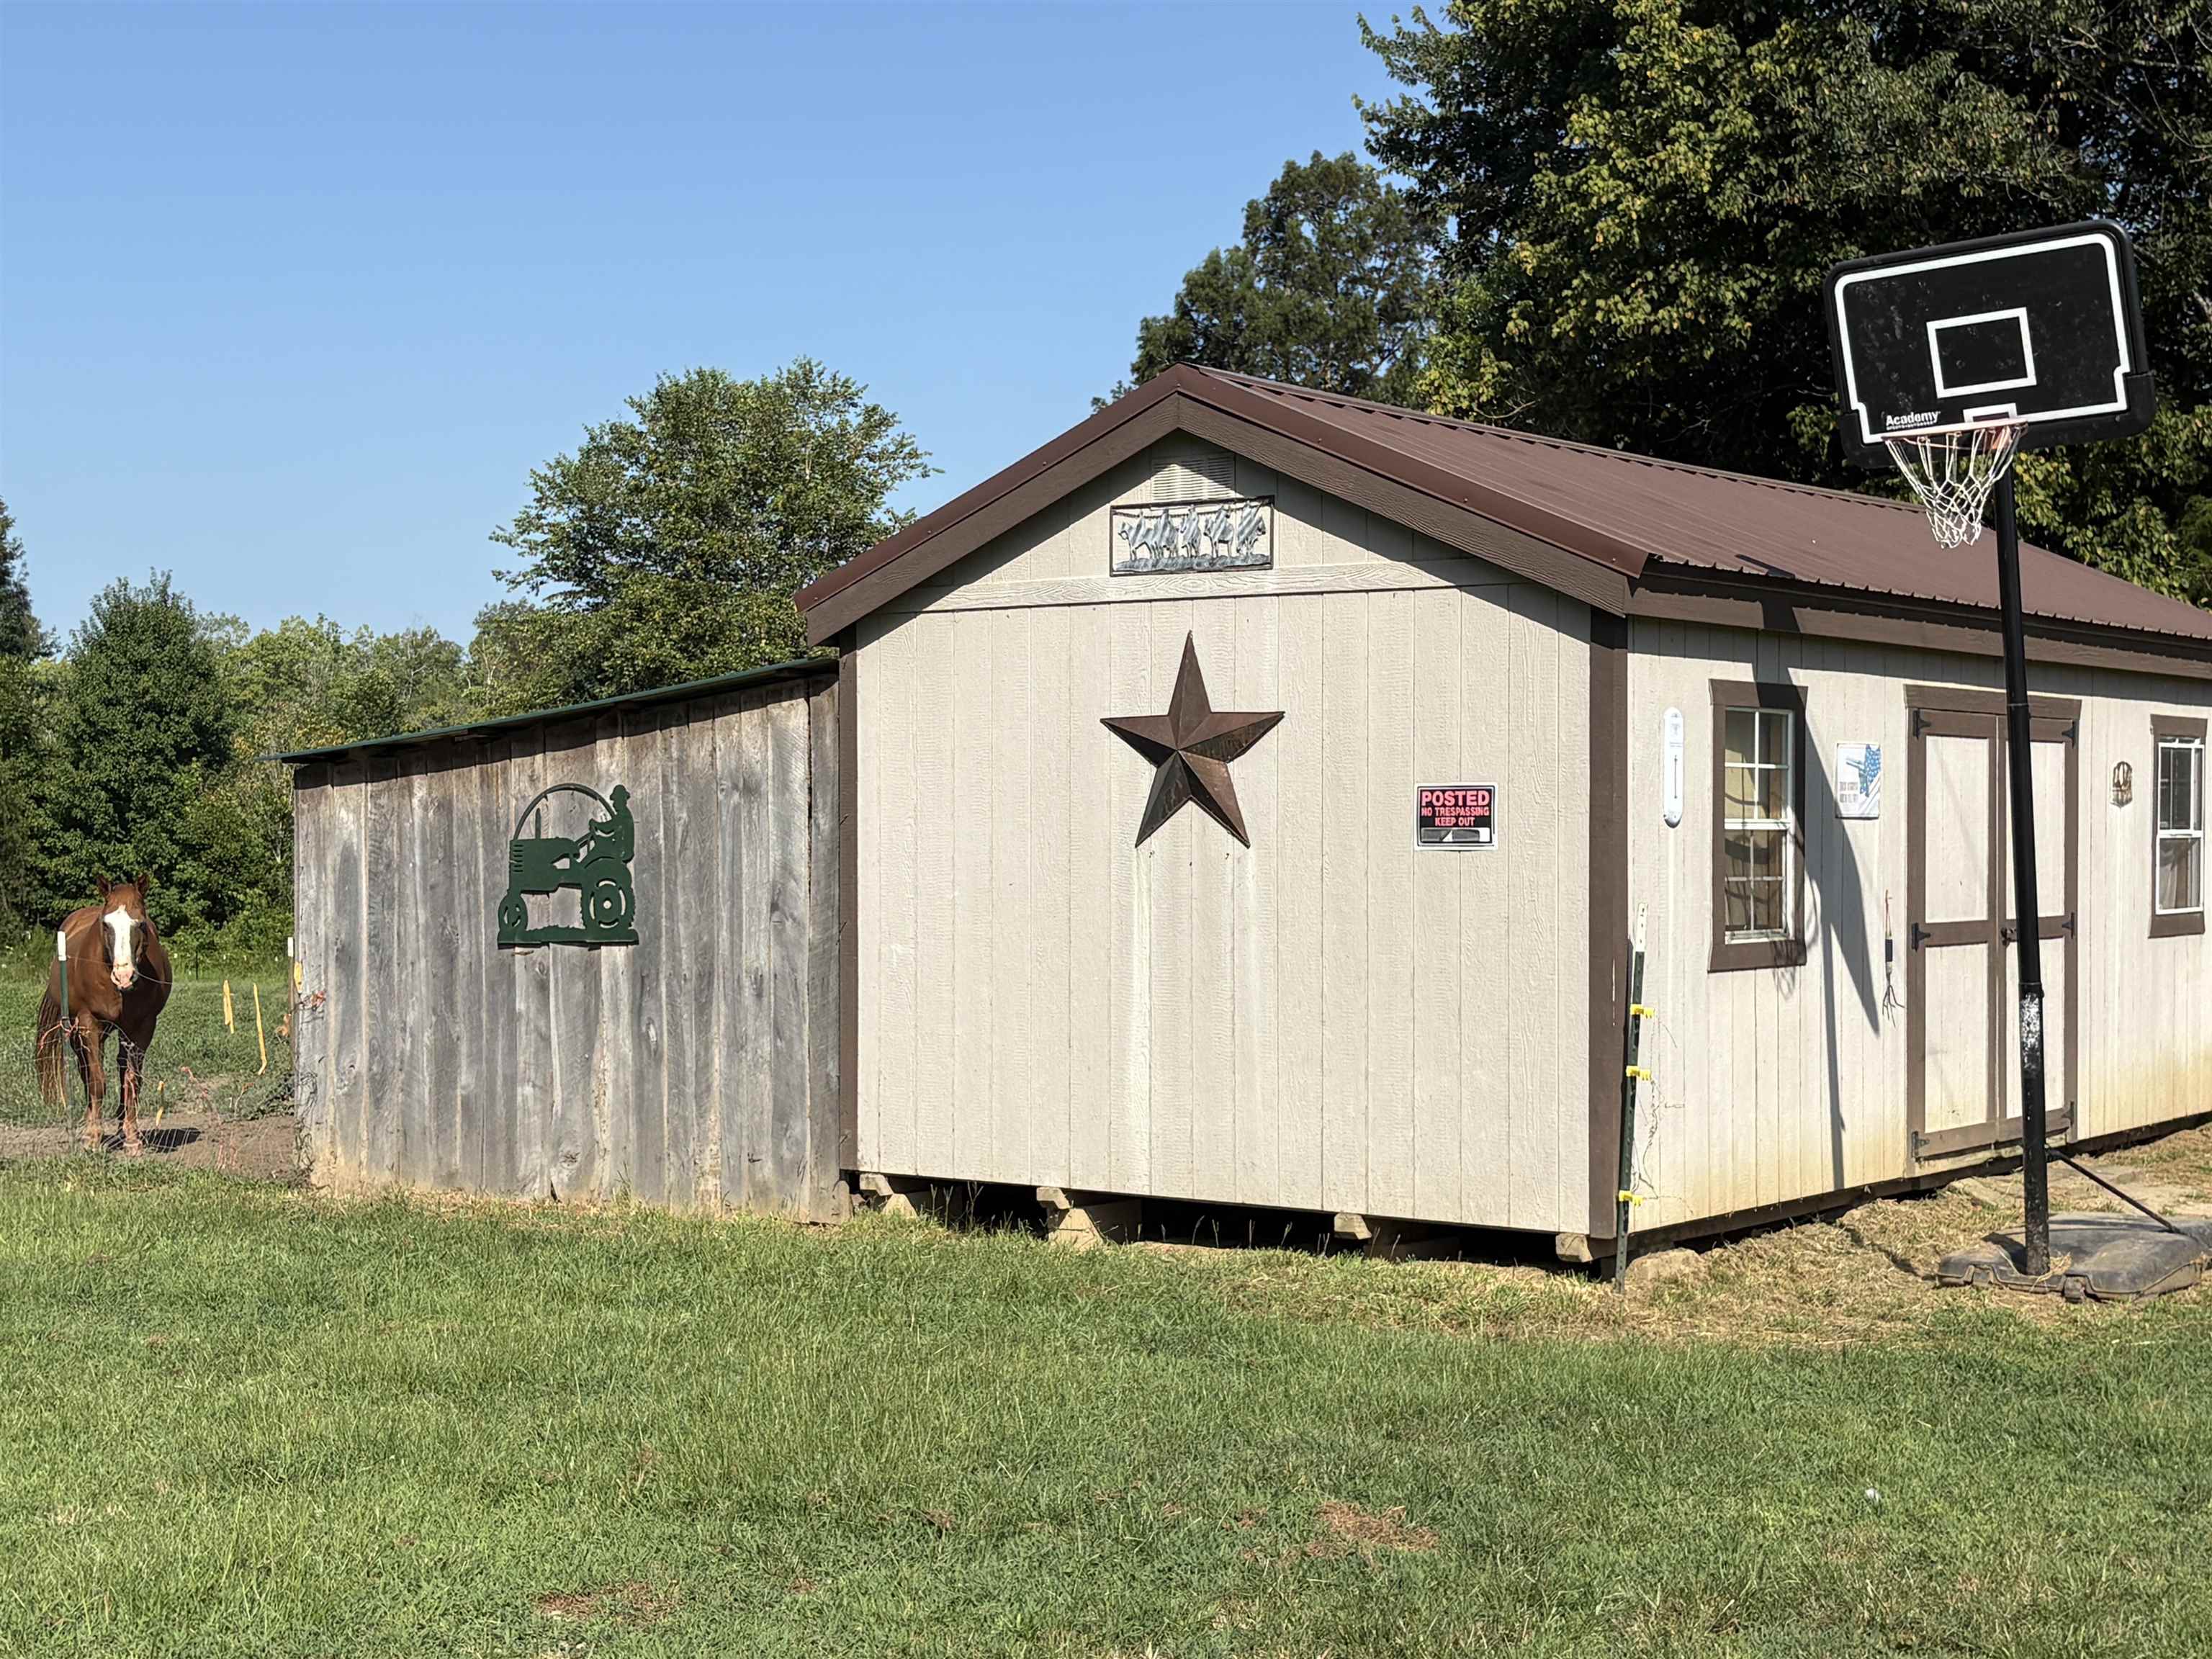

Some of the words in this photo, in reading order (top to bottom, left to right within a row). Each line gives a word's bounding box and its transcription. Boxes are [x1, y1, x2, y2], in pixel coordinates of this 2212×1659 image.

[1886, 411, 1939, 426] Academy
[1421, 790, 1490, 806] POSTED
[1421, 806, 1432, 817] NO
[1435, 806, 1490, 817] TRESPASSING
[1435, 817, 1456, 827] KEEP
[1458, 817, 1475, 827] OUT
